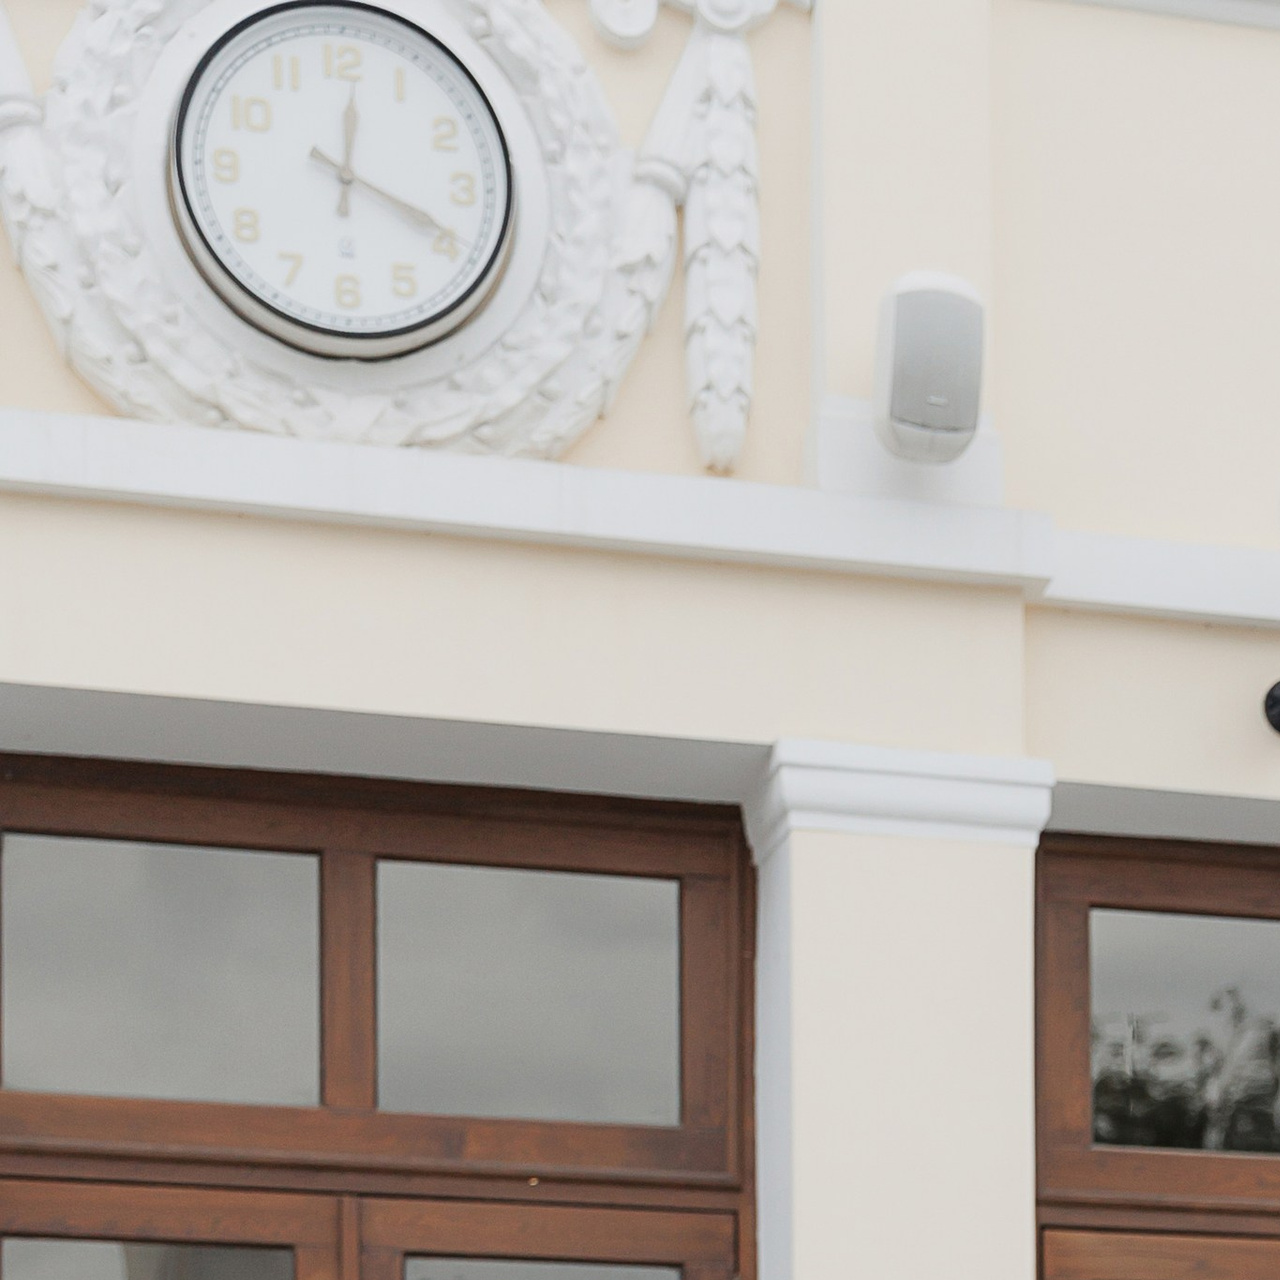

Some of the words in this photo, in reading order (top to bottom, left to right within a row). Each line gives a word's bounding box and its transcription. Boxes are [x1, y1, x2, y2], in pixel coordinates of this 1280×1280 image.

[272, 54, 301, 92] 11
[321, 43, 364, 83] 12
[394, 66, 406, 103] 1
[230, 94, 273, 133] 10
[430, 115, 459, 152] 2
[212, 146, 240, 184] 9
[449, 171, 477, 207] 3
[232, 206, 261, 244] 8
[430, 228, 459, 261] 4
[277, 250, 304, 287] 7
[390, 262, 418, 298] 5
[333, 273, 362, 309] 6
